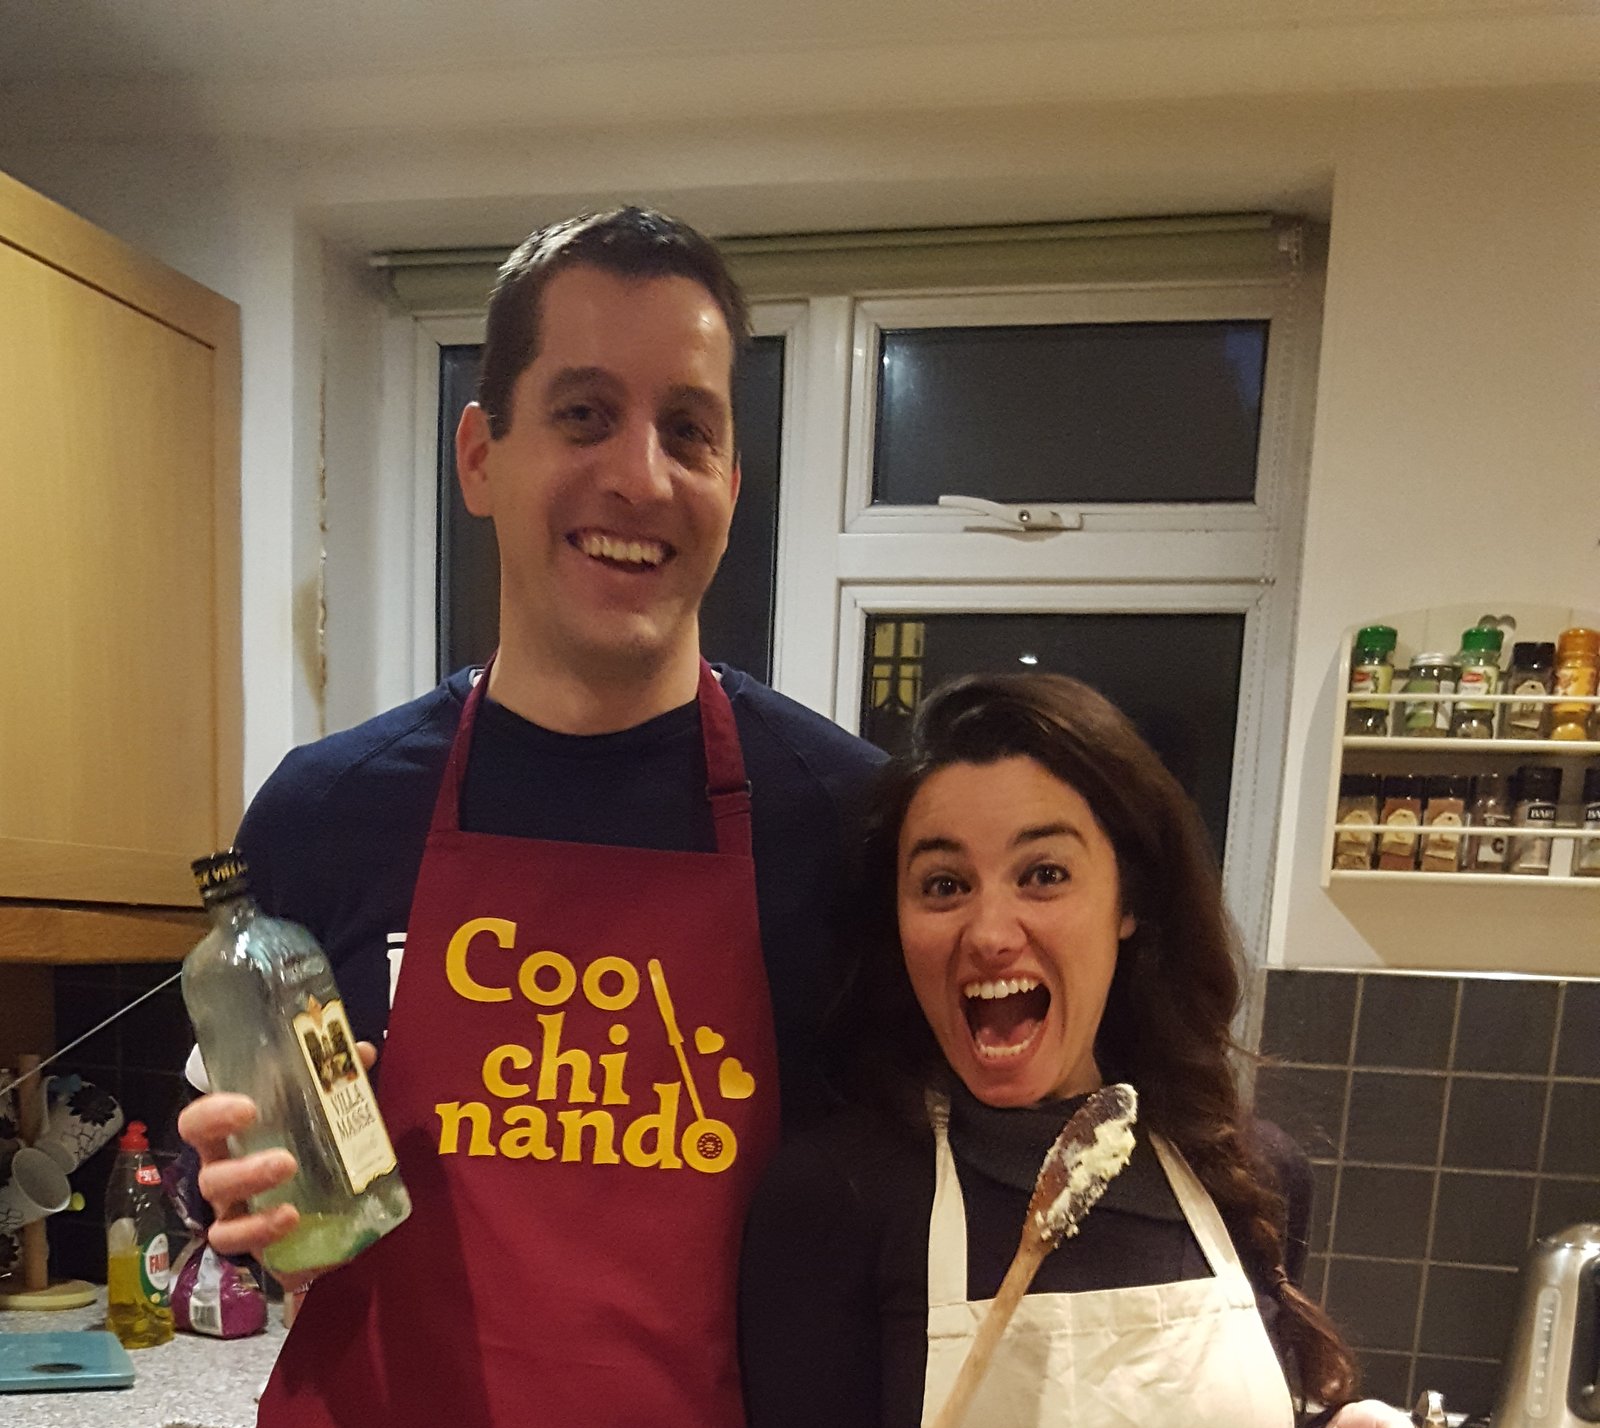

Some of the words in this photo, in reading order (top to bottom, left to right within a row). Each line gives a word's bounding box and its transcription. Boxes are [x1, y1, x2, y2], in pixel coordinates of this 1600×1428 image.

[331, 1083, 365, 1116] VILLA
[482, 1011, 631, 1105] chi
[435, 1081, 738, 1173] nando
